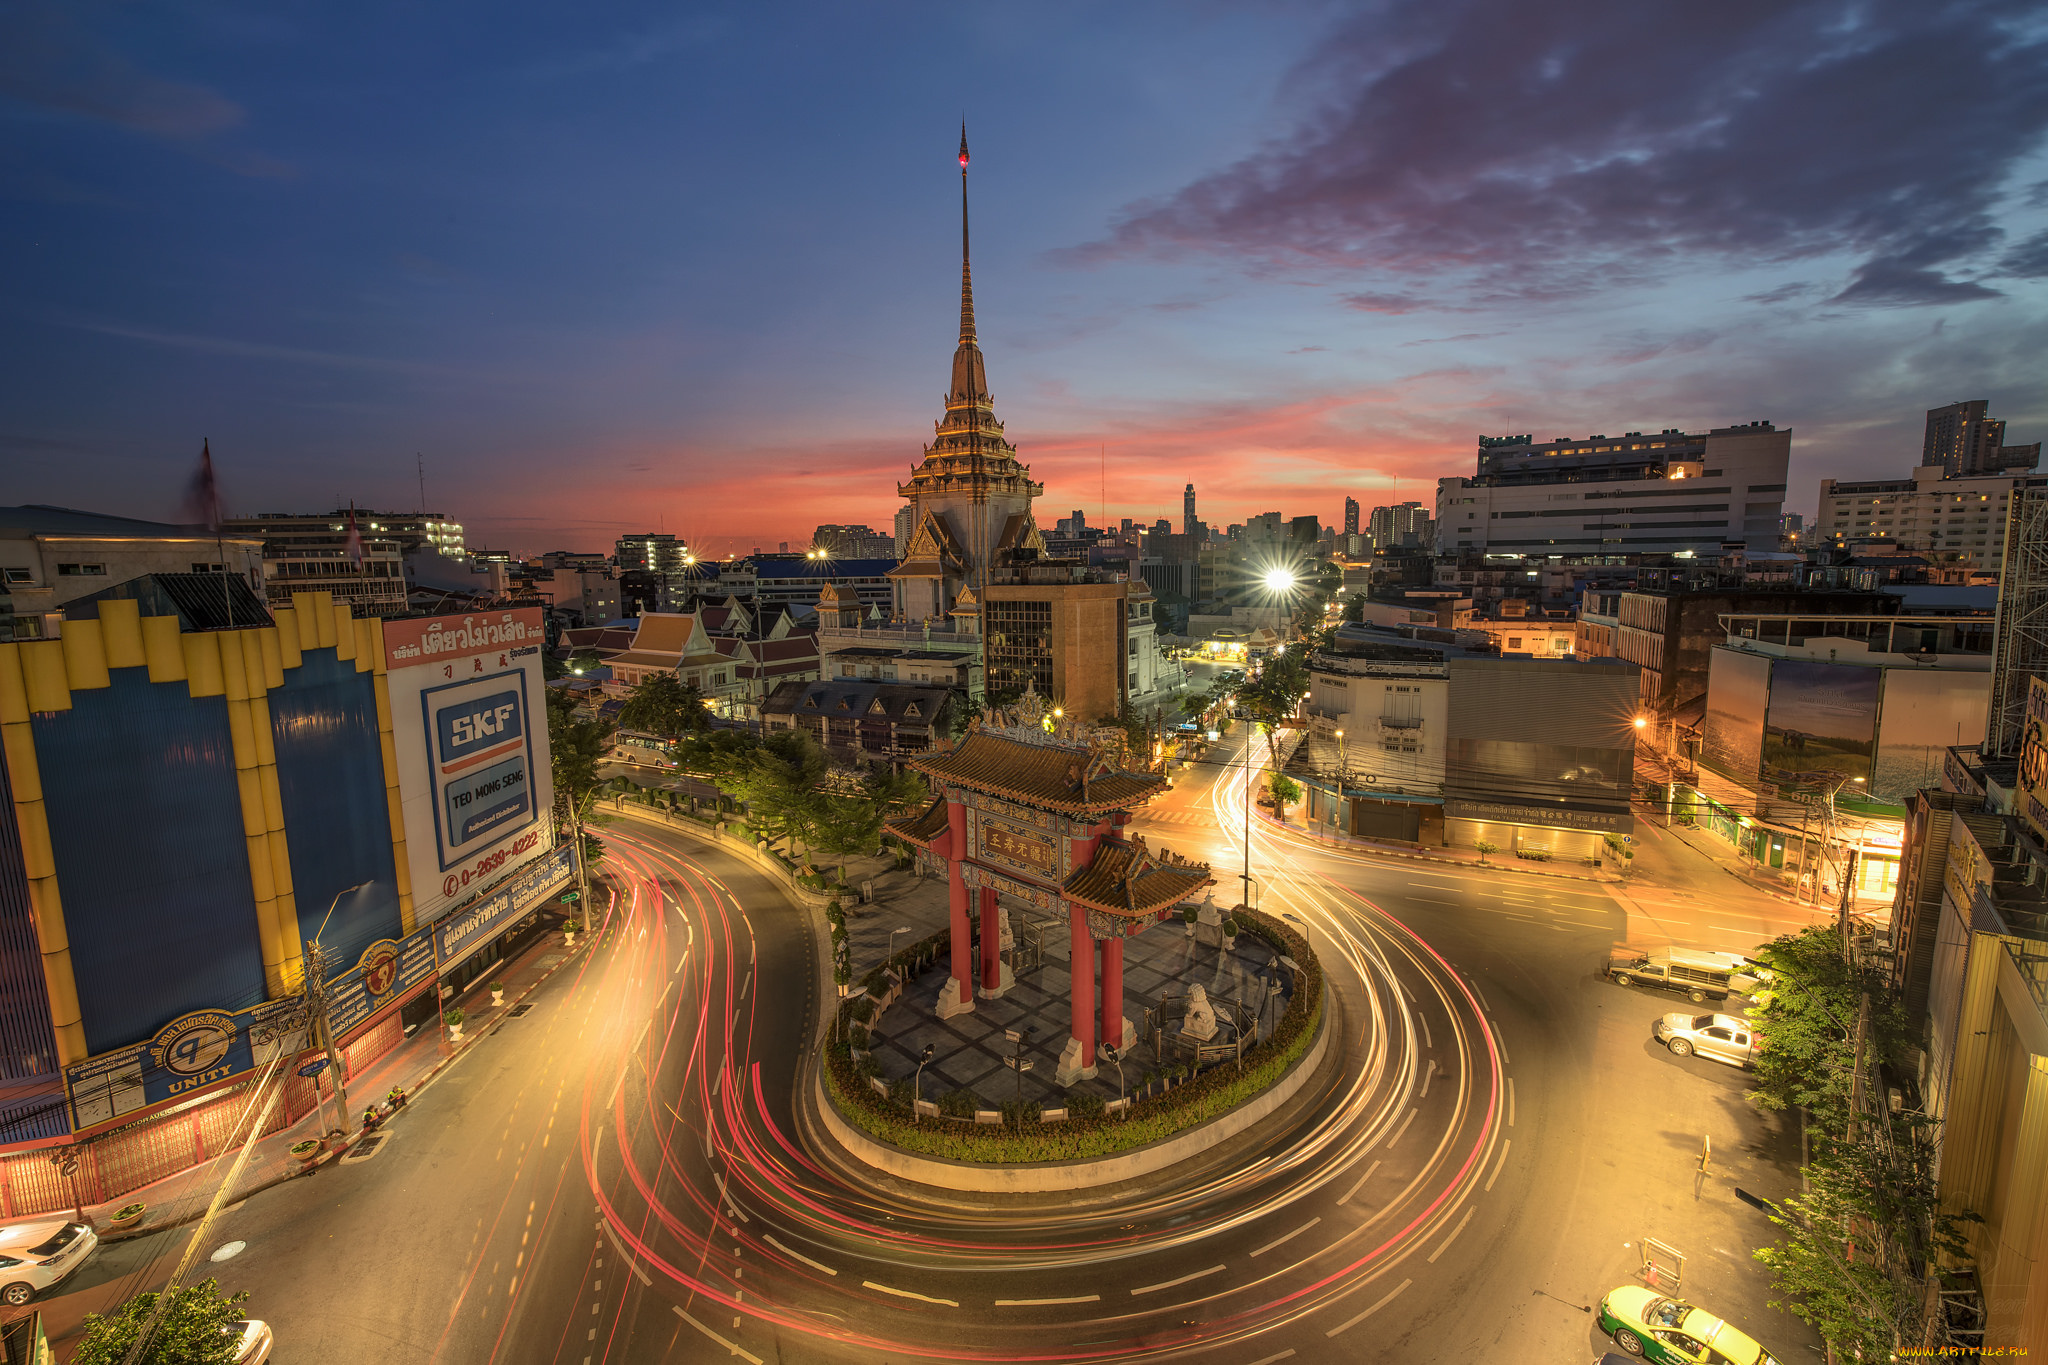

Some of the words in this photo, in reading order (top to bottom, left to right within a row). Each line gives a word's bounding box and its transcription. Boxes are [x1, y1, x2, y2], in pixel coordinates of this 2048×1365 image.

[392, 643, 421, 660] บริษัท
[451, 703, 514, 747] SKF
[452, 791, 472, 809] TEO
[475, 779, 501, 800] MONG
[502, 770, 524, 788] SENG
[461, 831, 539, 886] 0-2639-4222
[443, 895, 509, 956] ผู้แทนจำหน่าย
[167, 1064, 233, 1094] UNITY
